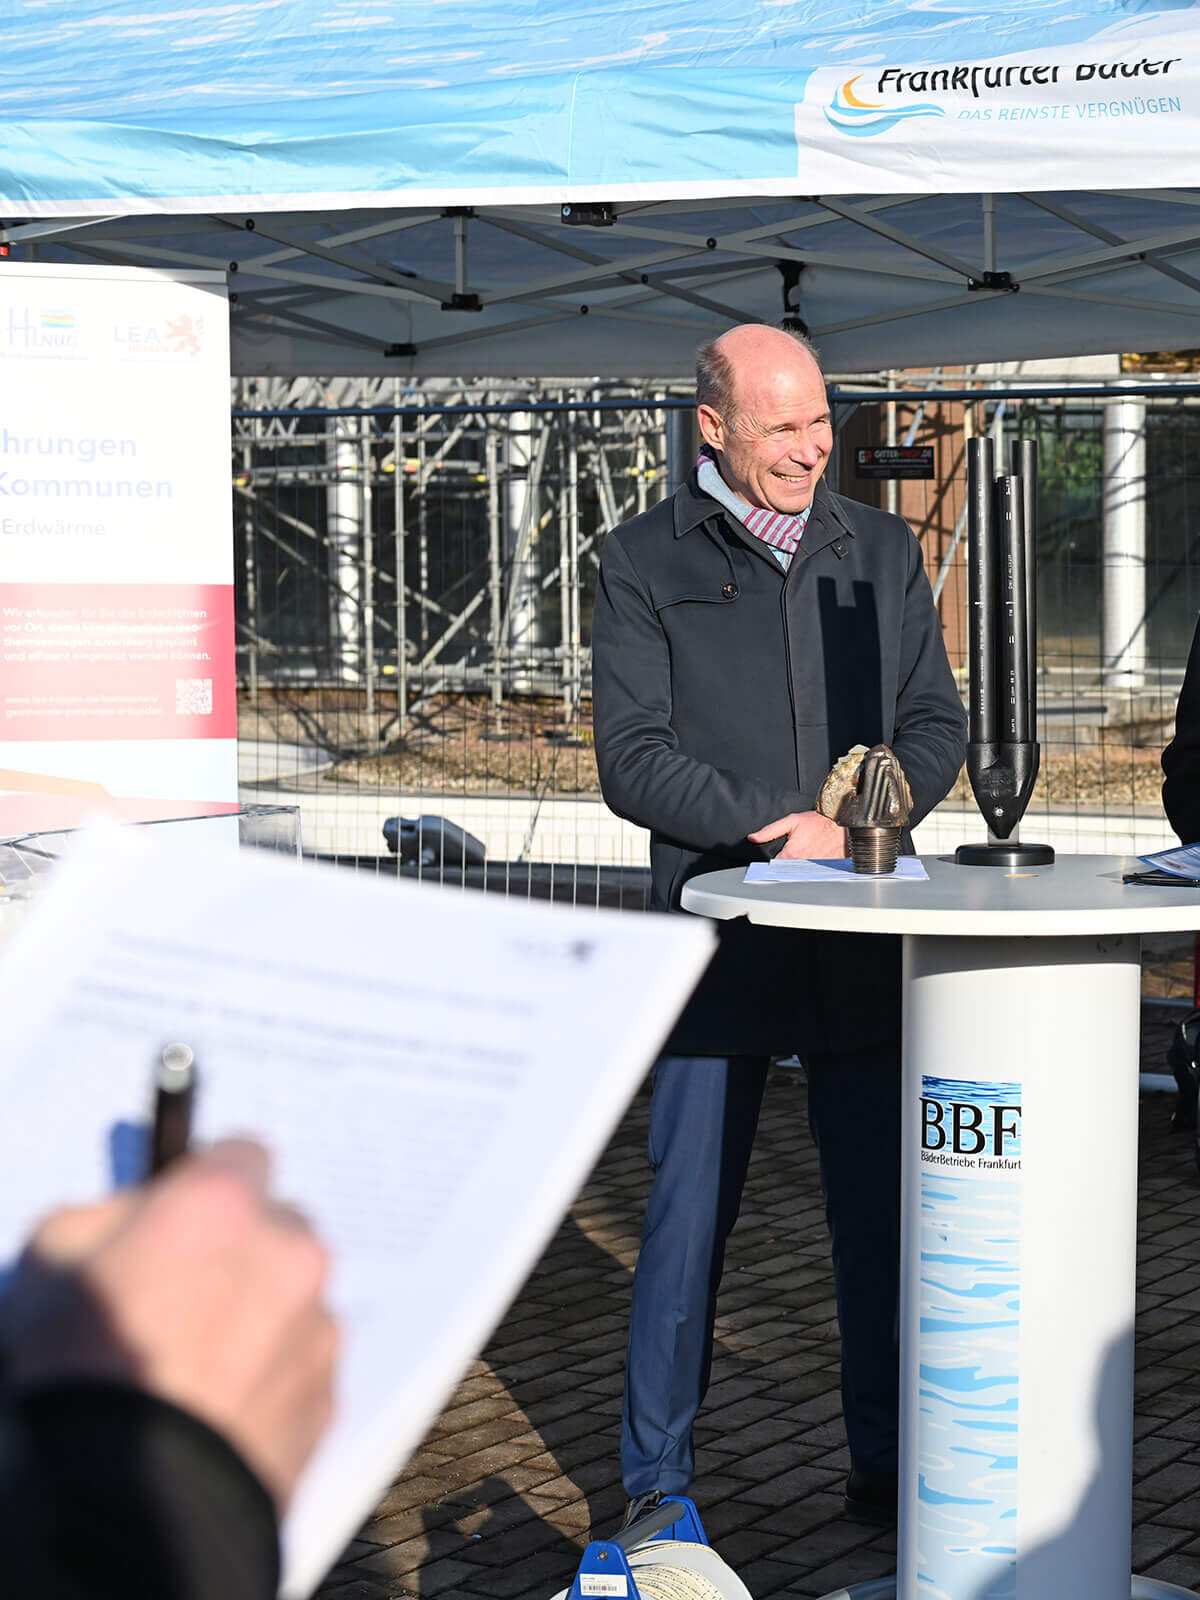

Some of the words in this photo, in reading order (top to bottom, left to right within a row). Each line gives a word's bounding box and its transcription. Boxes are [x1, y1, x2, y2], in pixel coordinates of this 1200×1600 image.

[957, 108, 992, 121] DAS
[998, 104, 1072, 121] REINSTE
[1076, 96, 1182, 119] VERGNÜGEN
[2, 517, 105, 536] Erdwärme
[919, 1097, 1022, 1156] BBF
[920, 1150, 976, 1168] BäderBetriebe
[978, 1157, 1022, 1169] Frankfurt
